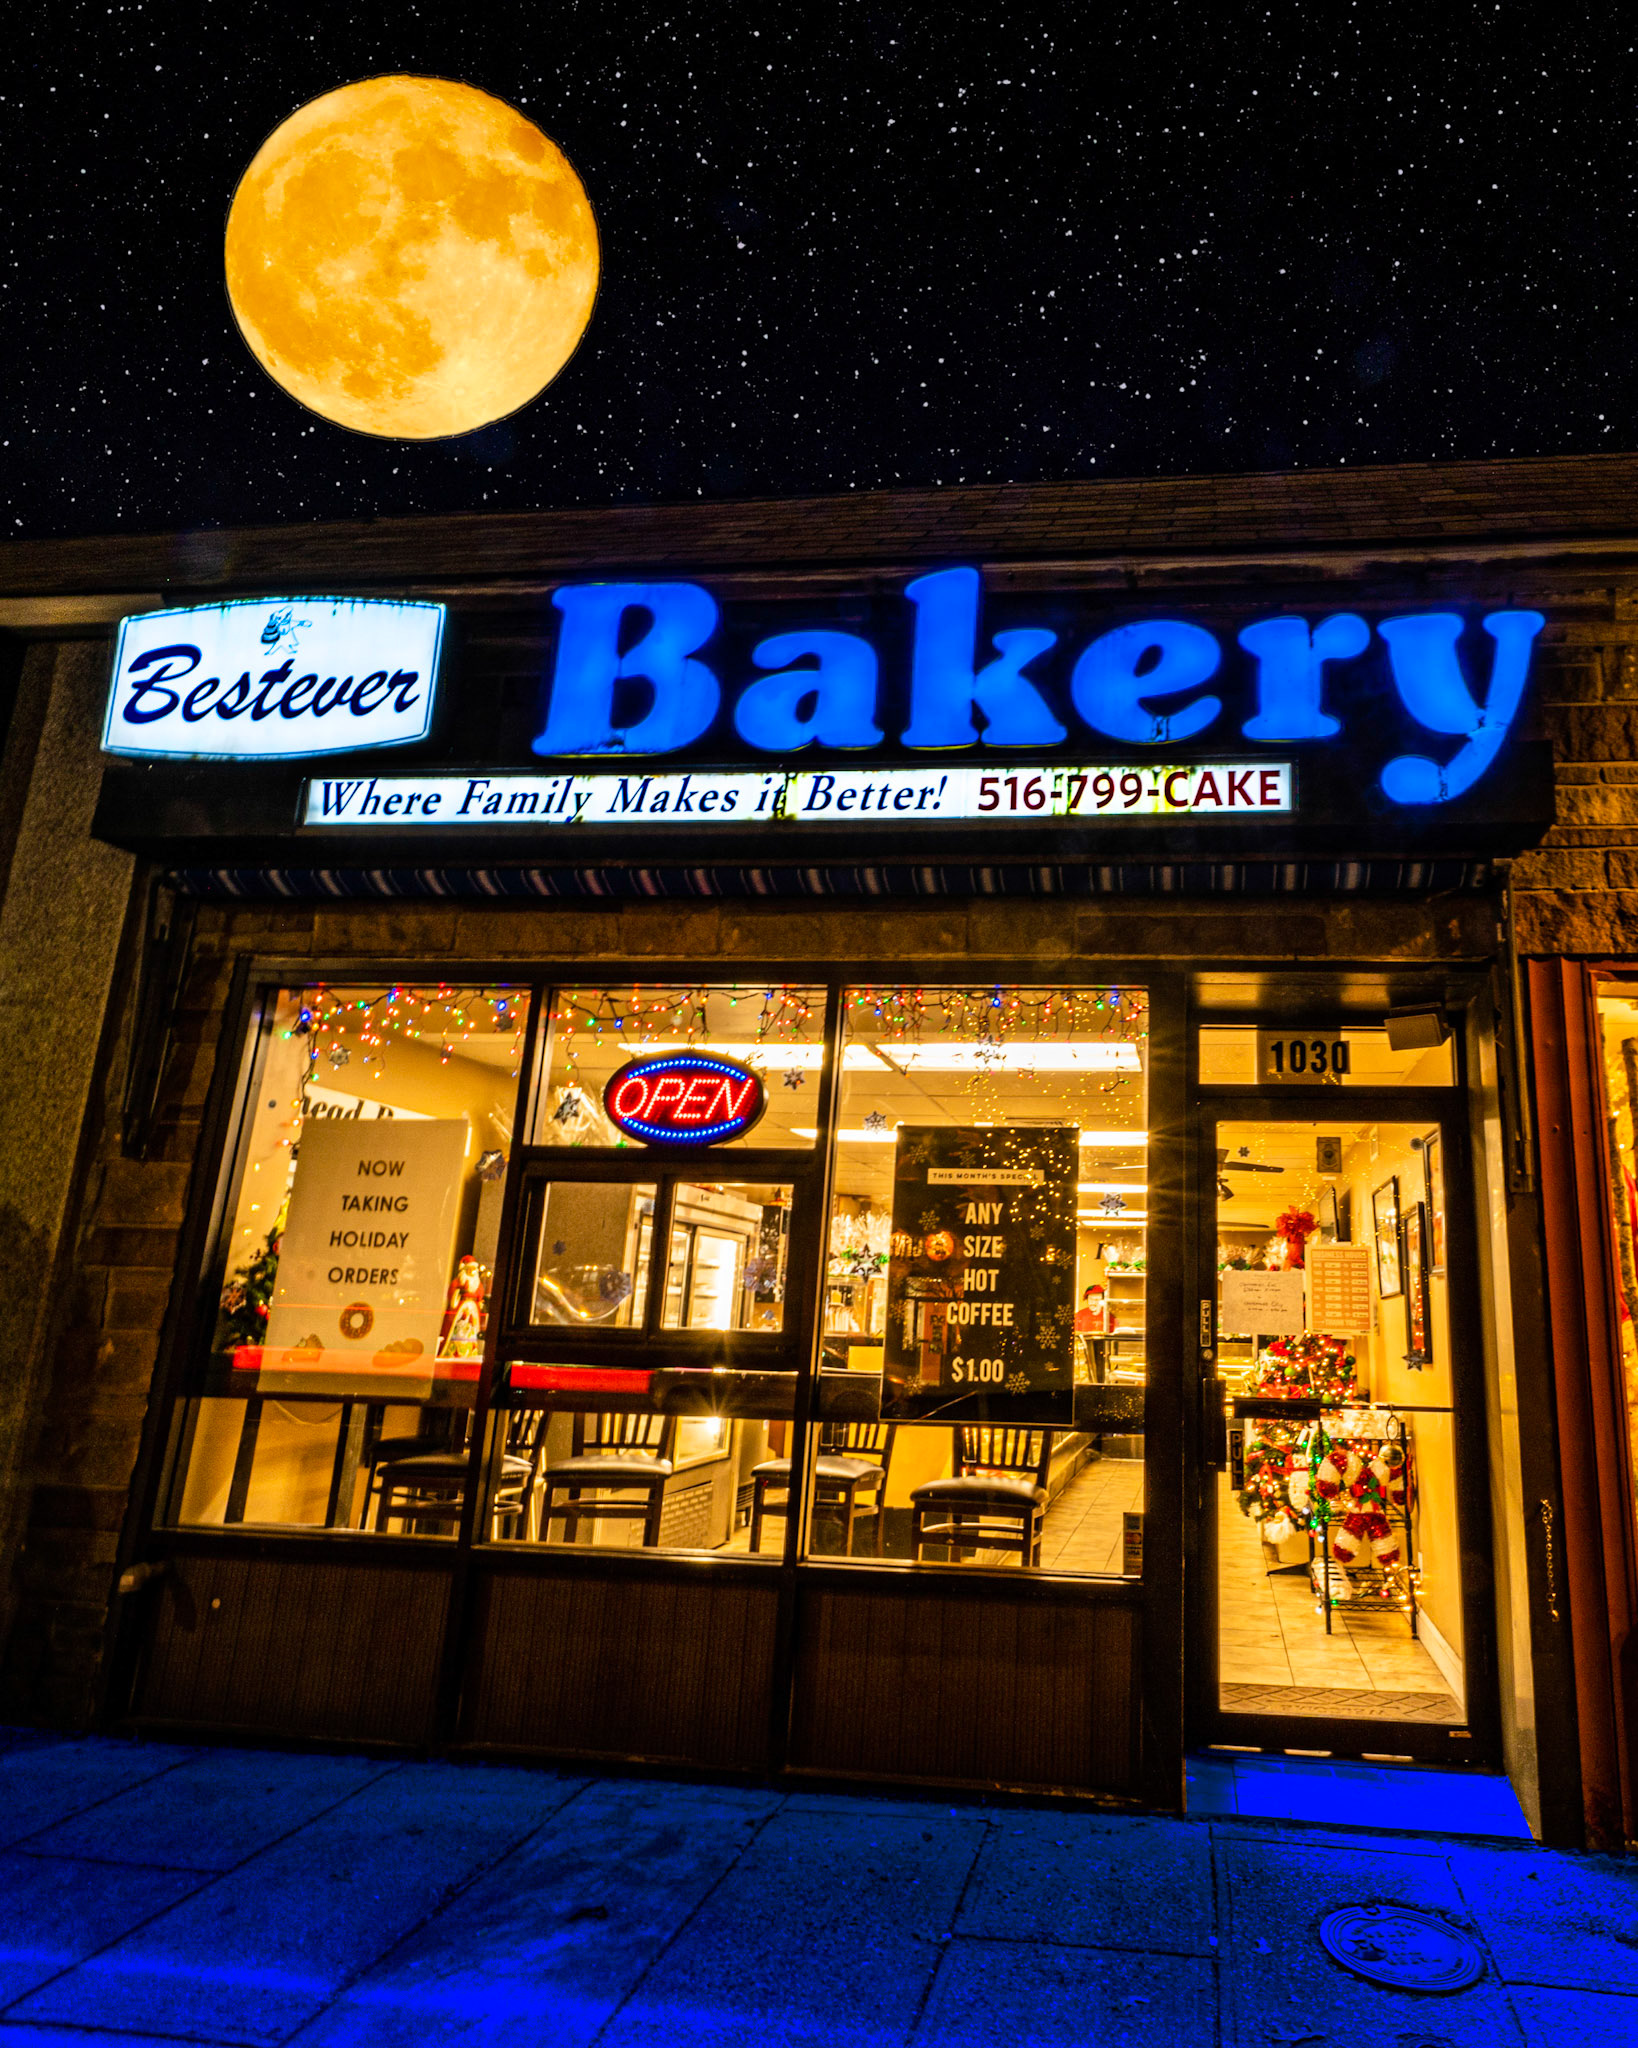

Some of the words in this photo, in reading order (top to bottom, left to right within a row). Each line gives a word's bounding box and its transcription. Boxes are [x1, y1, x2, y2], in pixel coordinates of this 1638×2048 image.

[122, 644, 421, 724] Bestever
[532, 566, 1546, 804] Bakery
[320, 779, 442, 816] Where
[457, 778, 592, 822] Family
[606, 775, 739, 812] Makes
[756, 773, 785, 813] it
[803, 771, 948, 812] Better!
[978, 769, 1282, 813] 516-799-CAKE
[1270, 1040, 1347, 1074] 1030
[613, 1076, 754, 1119] OPEN
[357, 1160, 406, 1177] NOW
[932, 1172, 953, 1180] THIS
[956, 1172, 997, 1181] MONTH'S
[342, 1194, 409, 1212] TAKING
[965, 1202, 1004, 1225] ANY
[329, 1230, 410, 1249] HOLIDAY
[963, 1235, 1004, 1258] SIZE
[327, 1267, 399, 1285] ORDERS
[963, 1268, 1000, 1292] HOT
[946, 1302, 1014, 1326] COFFEE
[1202, 1302, 1210, 1333] PULL
[951, 1356, 1005, 1383] $1.00
